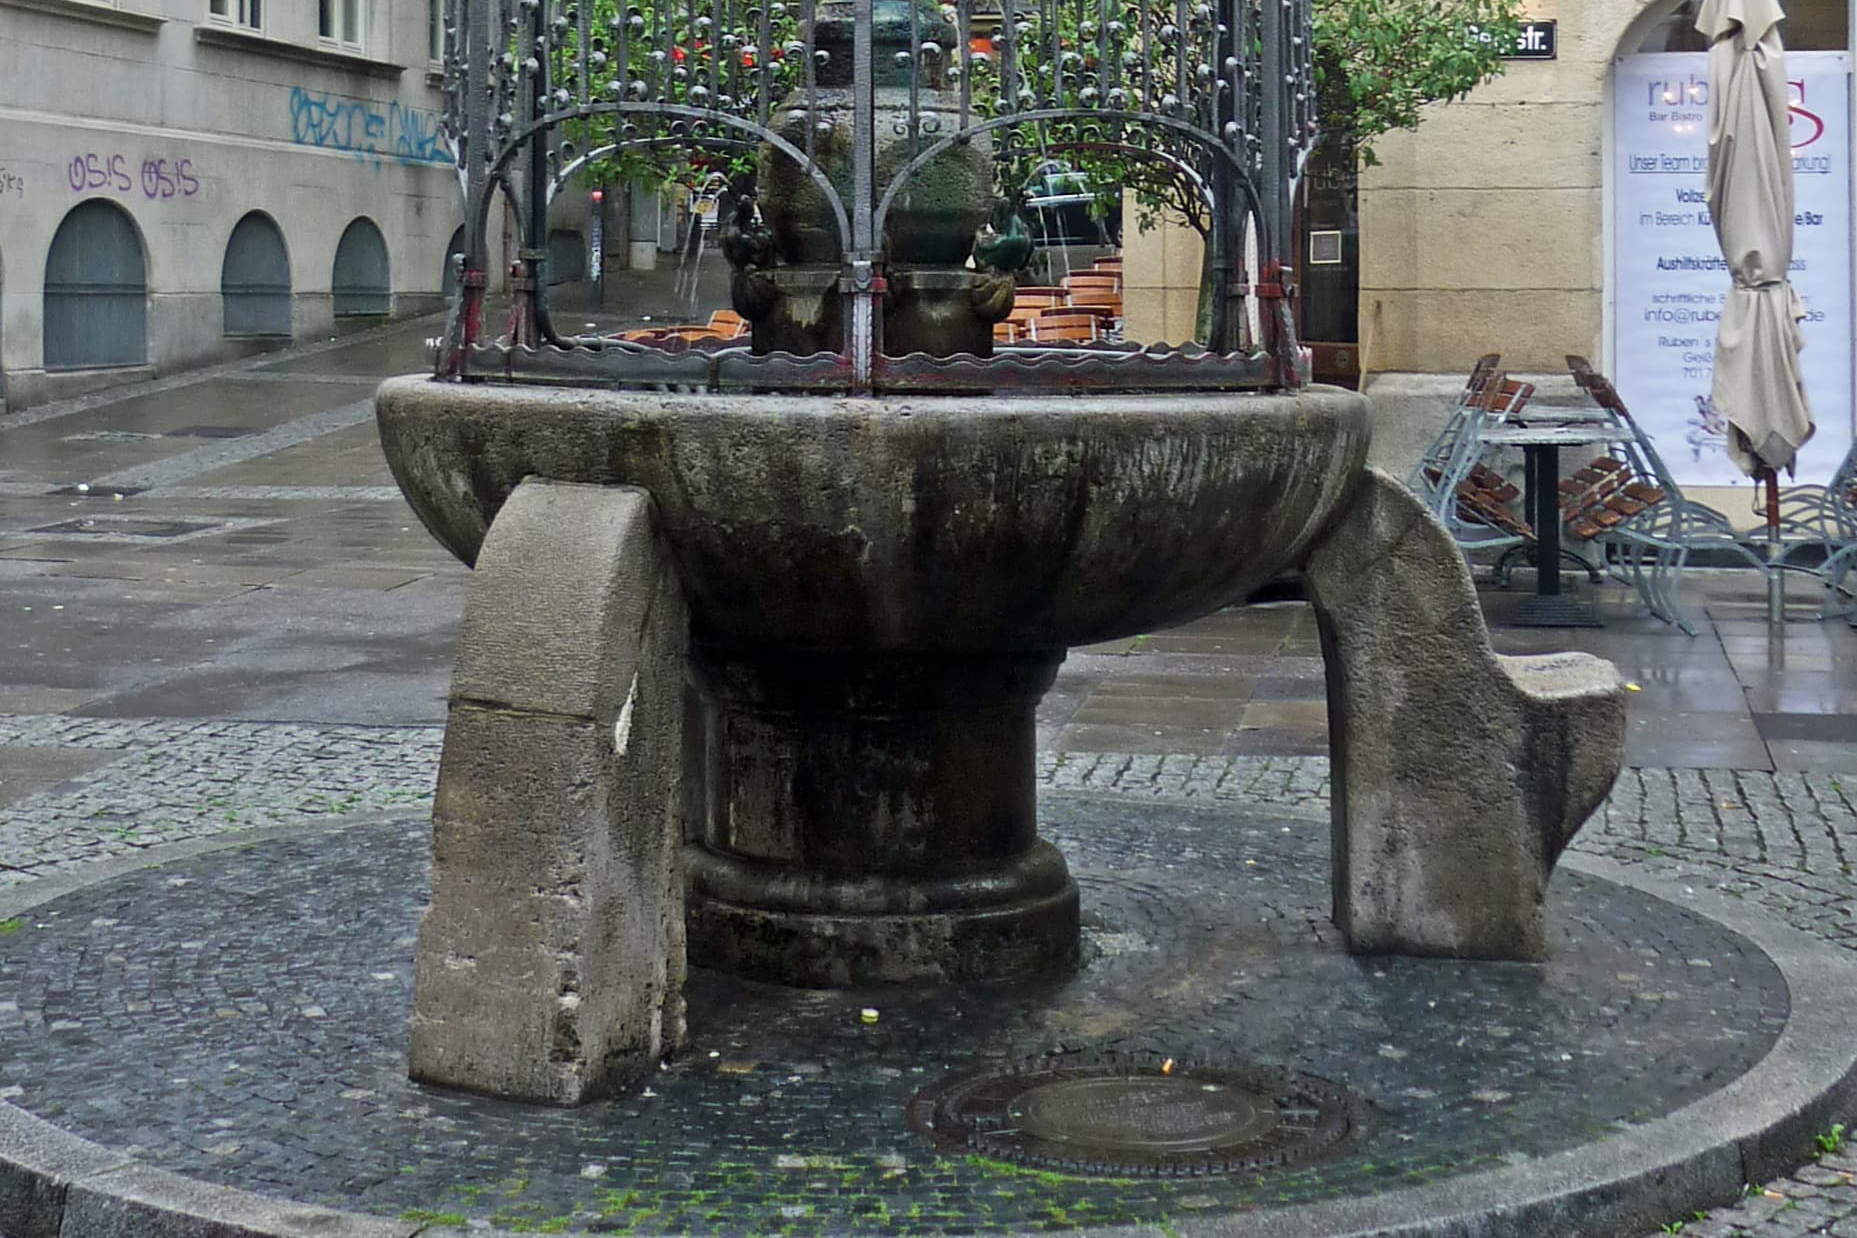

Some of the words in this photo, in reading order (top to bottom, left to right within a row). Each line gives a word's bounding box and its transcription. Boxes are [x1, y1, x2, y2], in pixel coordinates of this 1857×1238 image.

[1649, 111, 1668, 122] Bar
[1671, 111, 1704, 122] Bistro
[1628, 153, 1657, 170] Unser
[1660, 153, 1690, 170] Team
[1676, 188, 1705, 203] Vollze
[1656, 211, 1696, 226] Bereich
[1805, 211, 1824, 225] Bar
[1658, 336, 1698, 347] Ruben
[1682, 351, 1713, 363] Geiß
